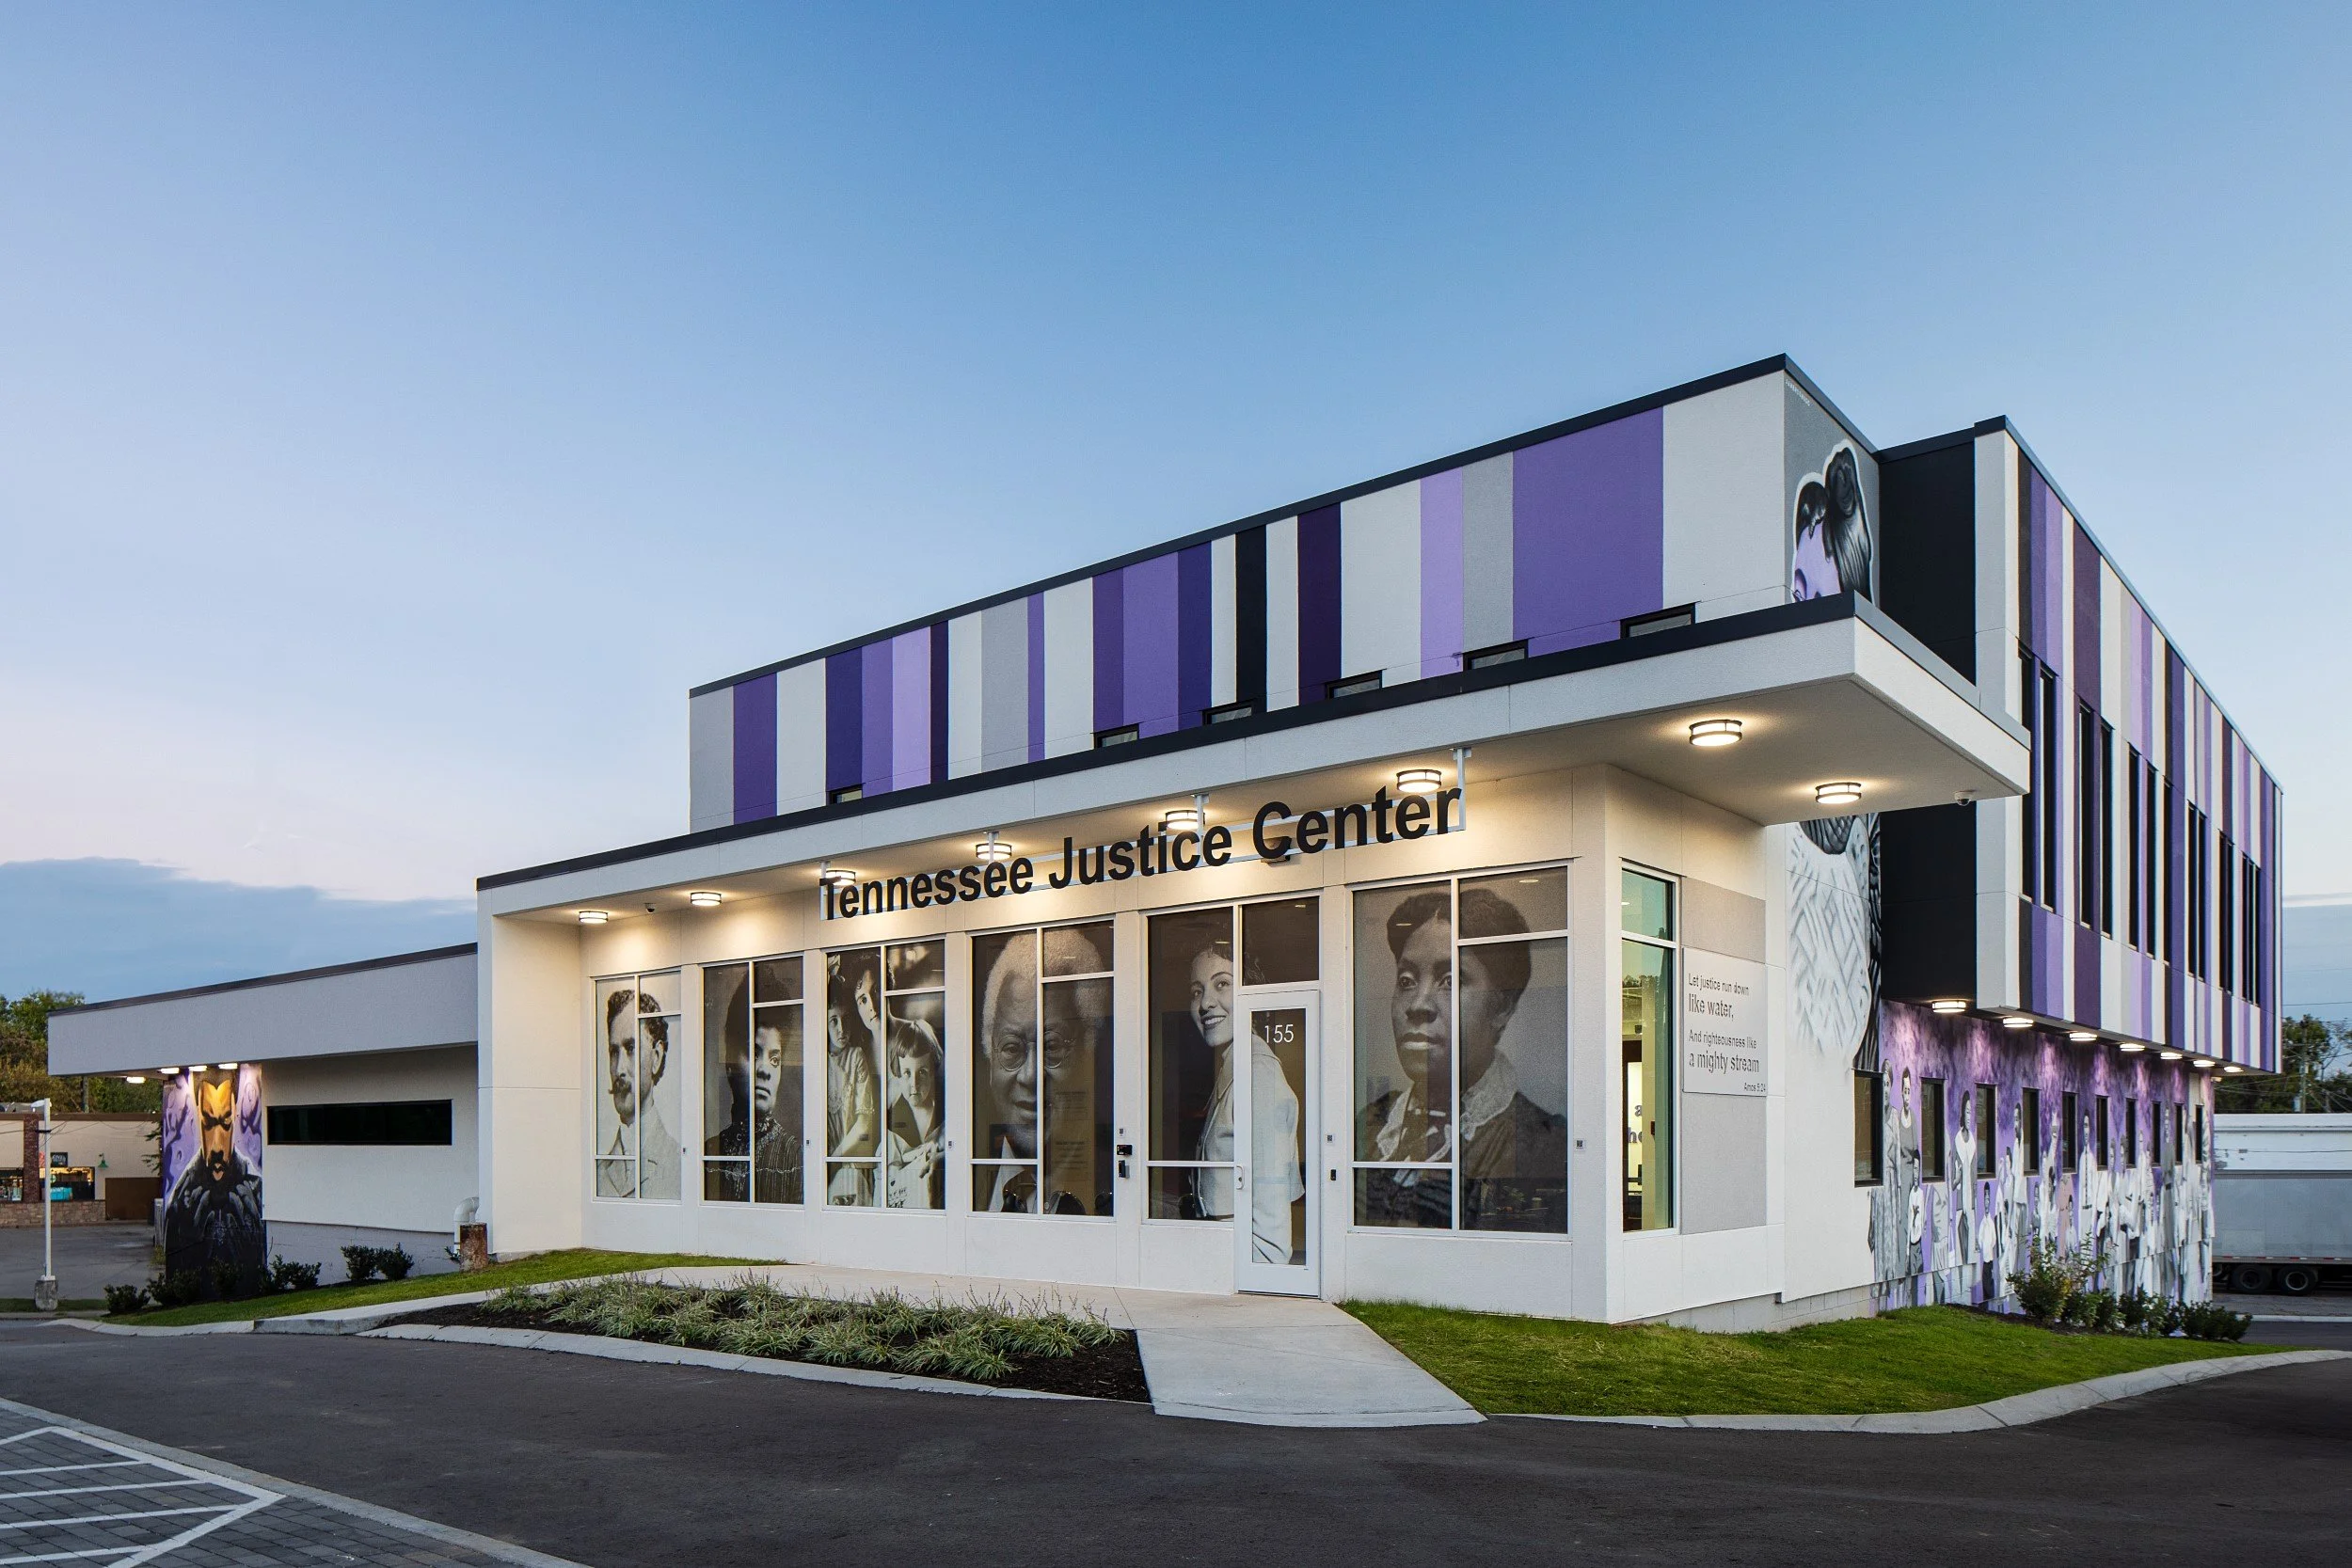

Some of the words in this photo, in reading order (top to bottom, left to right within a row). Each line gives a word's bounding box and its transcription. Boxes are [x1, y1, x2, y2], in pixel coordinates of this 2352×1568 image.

[819, 857, 1033, 921] Tennessee
[1048, 820, 1232, 889] Justice
[1252, 785, 1462, 859] Center
[1689, 974, 1699, 987] Let
[1700, 975, 1721, 990] justice
[1722, 982, 1732, 992] run
[1734, 982, 1749, 995] down
[1689, 993, 1705, 1013] like
[1708, 1000, 1734, 1022] water,
[1264, 1024, 1295, 1043] 155
[1689, 1030, 1702, 1042] And
[1704, 1032, 1745, 1047] righteousness
[1747, 1037, 1756, 1049] like
[1689, 1053, 1694, 1068] a
[1697, 1050, 1728, 1074] mighty
[1730, 1054, 1759, 1072] stream
[1744, 1083, 1756, 1091] Amos
